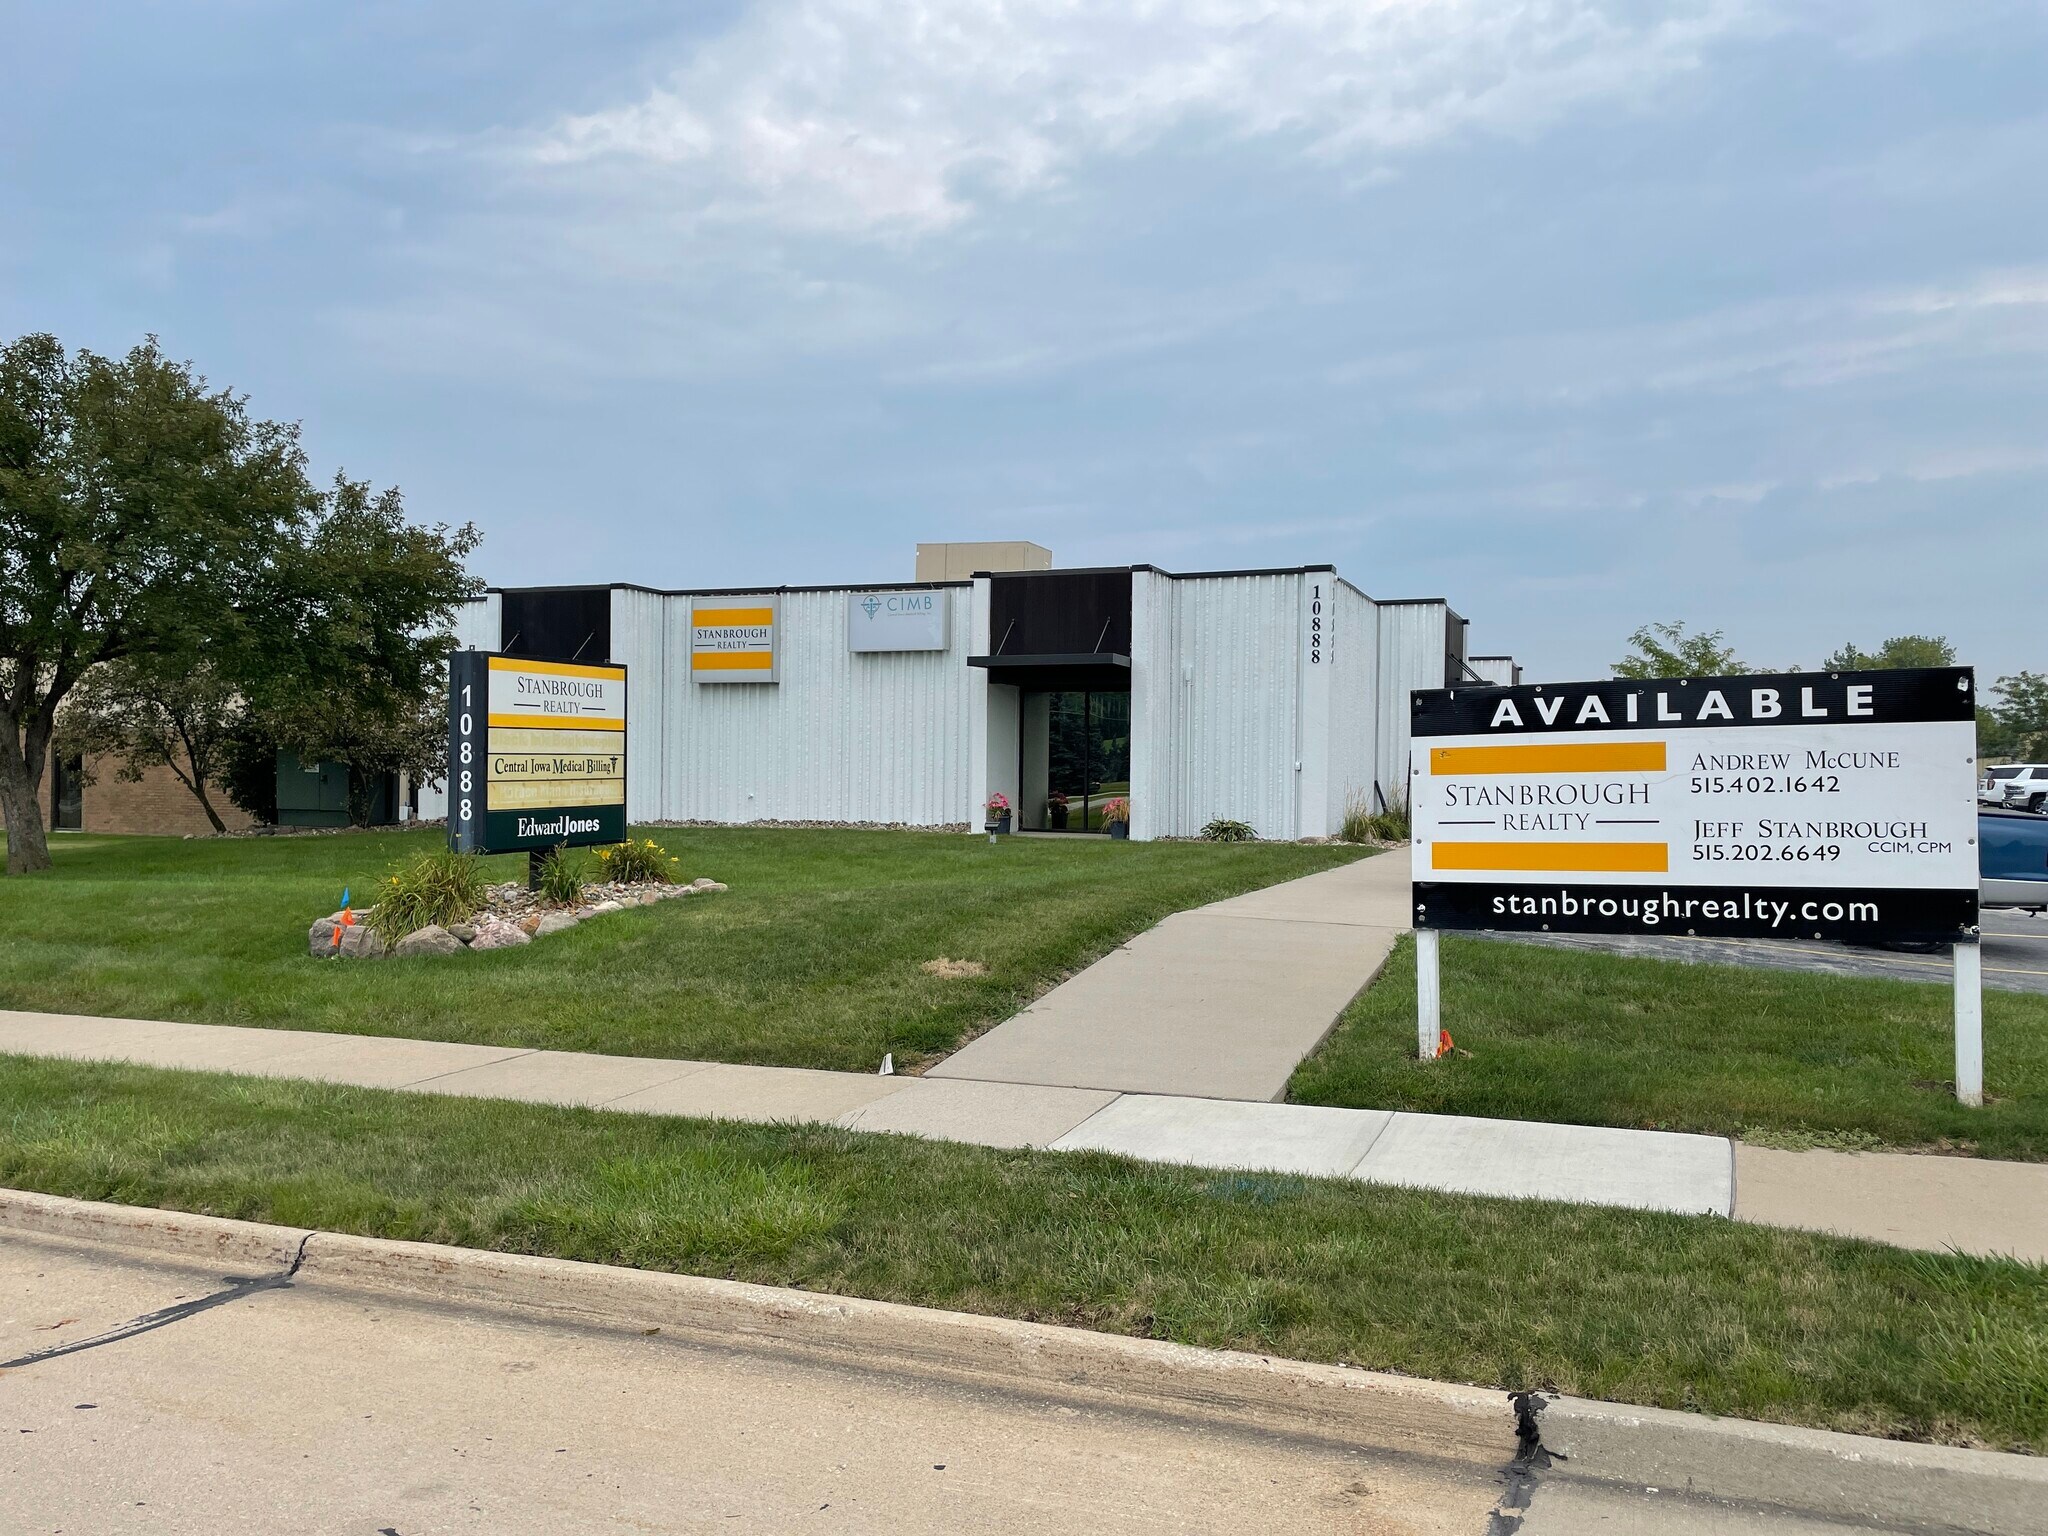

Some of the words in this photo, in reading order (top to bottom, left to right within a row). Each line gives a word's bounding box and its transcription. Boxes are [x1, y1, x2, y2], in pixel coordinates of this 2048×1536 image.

[887, 596, 932, 612] CIMB
[1311, 585, 1321, 663] 10888
[697, 628, 767, 640] STANBROUGH
[717, 641, 747, 649] REALTY
[517, 676, 603, 698] STANBROUGH
[543, 700, 580, 714] REALTY
[1490, 685, 1874, 727] AVAILABLE
[460, 684, 473, 821] 10888
[1691, 752, 1790, 771] ANDREW
[1806, 750, 1900, 769] McCUNE
[494, 758, 528, 774] Central
[531, 758, 550, 773] Iowa
[552, 758, 585, 774] Medical
[586, 757, 611, 775] Billing
[1691, 776, 1841, 794] 515.402.1642
[1445, 783, 1650, 807] STANBROUGH
[1502, 813, 1591, 831] REALTY
[1694, 820, 1743, 841] JEFF
[1758, 818, 1928, 840] STANBROUGH
[1692, 844, 1842, 862] 515.202.6649
[1868, 841, 1914, 855] CCIM,
[1917, 842, 1952, 854] CPM
[1493, 891, 1879, 928] stanbroughrealty.com
